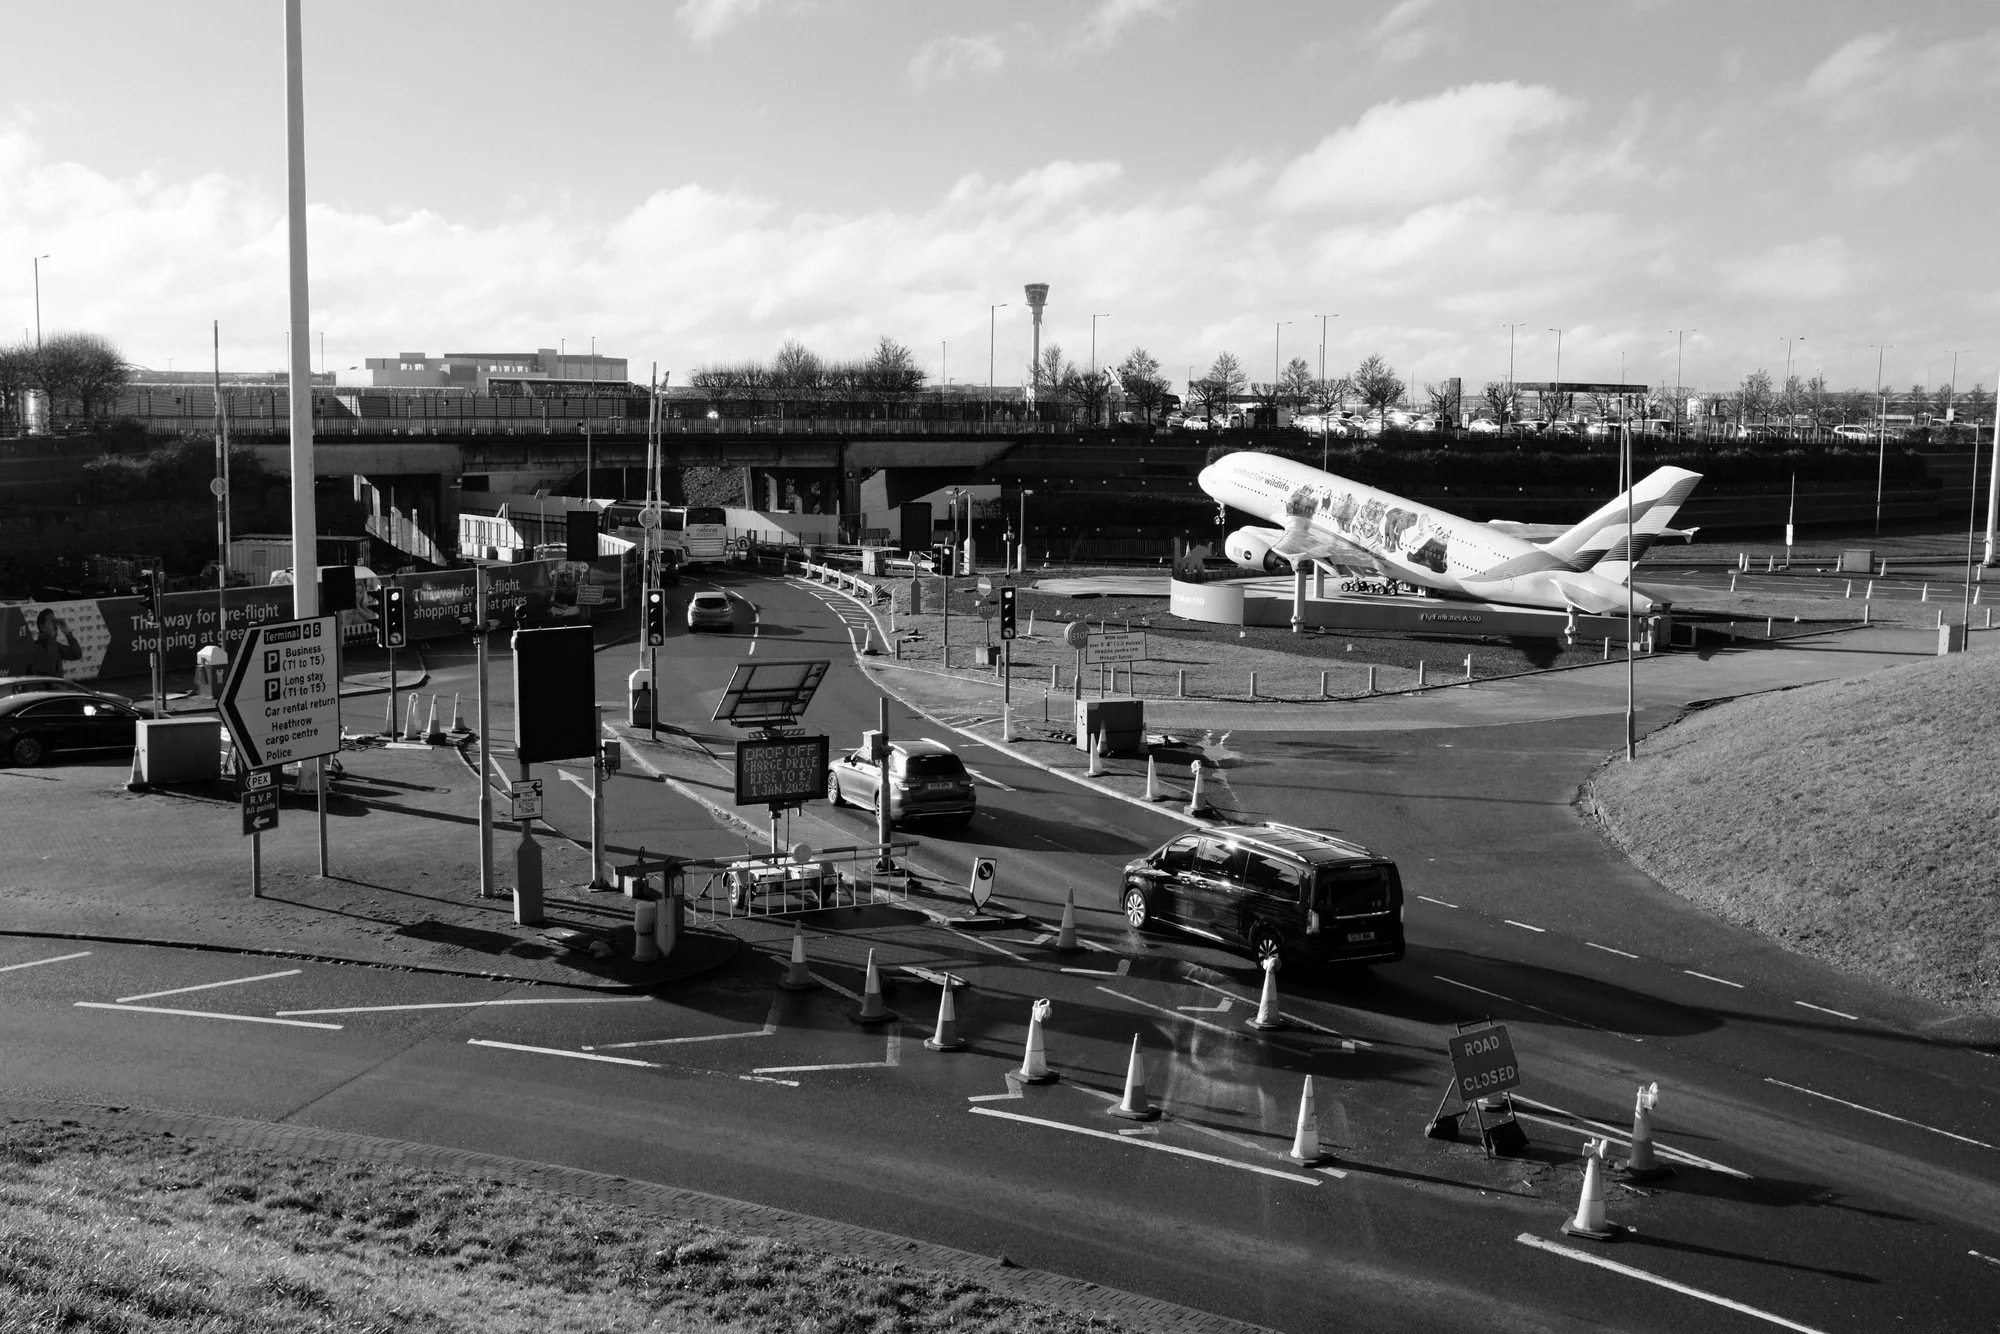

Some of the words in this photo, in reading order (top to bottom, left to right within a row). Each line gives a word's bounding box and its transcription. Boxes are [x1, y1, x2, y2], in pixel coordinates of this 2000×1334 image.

[1265, 477, 1290, 492] wildlife
[412, 588, 435, 602] This
[436, 587, 458, 601] way
[461, 583, 476, 597] for
[414, 603, 460, 620] shopping
[462, 602, 473, 613] at
[502, 595, 527, 612] prices
[979, 605, 996, 613] STOP
[164, 614, 193, 629] way
[197, 609, 216, 624] for
[131, 631, 196, 652] shoping
[200, 630, 214, 644] at
[217, 629, 245, 646] grea
[265, 628, 299, 643] Terminal
[286, 645, 321, 659] Business
[267, 652, 279, 672] P
[283, 660, 296, 672] (T1
[299, 658, 307, 668] to
[310, 654, 325, 666] T5)
[285, 675, 305, 687] Long
[307, 672, 324, 682] stay
[268, 680, 279, 700] P
[283, 688, 297, 700] (T1
[299, 685, 307, 695] to
[311, 682, 326, 693] T5)
[265, 707, 280, 718] Car
[282, 701, 308, 714] rental
[310, 697, 336, 709] return
[271, 717, 313, 732] Heathrow
[265, 733, 290, 746] cargo
[292, 727, 319, 740] centre
[266, 748, 293, 761] Police
[745, 746, 782, 761] DROP
[788, 743, 817, 757] OFF
[743, 758, 783, 773] CHARGE
[786, 756, 818, 769] PRICE
[252, 775, 268, 786] PEX
[750, 771, 777, 785] RISE
[781, 770, 795, 782] TO
[799, 768, 813, 781] £7
[752, 785, 758, 797] 1
[761, 783, 782, 796] JAN
[246, 806, 255, 815] All
[1464, 1035, 1500, 1057] ROAD
[1463, 1065, 1515, 1091] CLOSED
